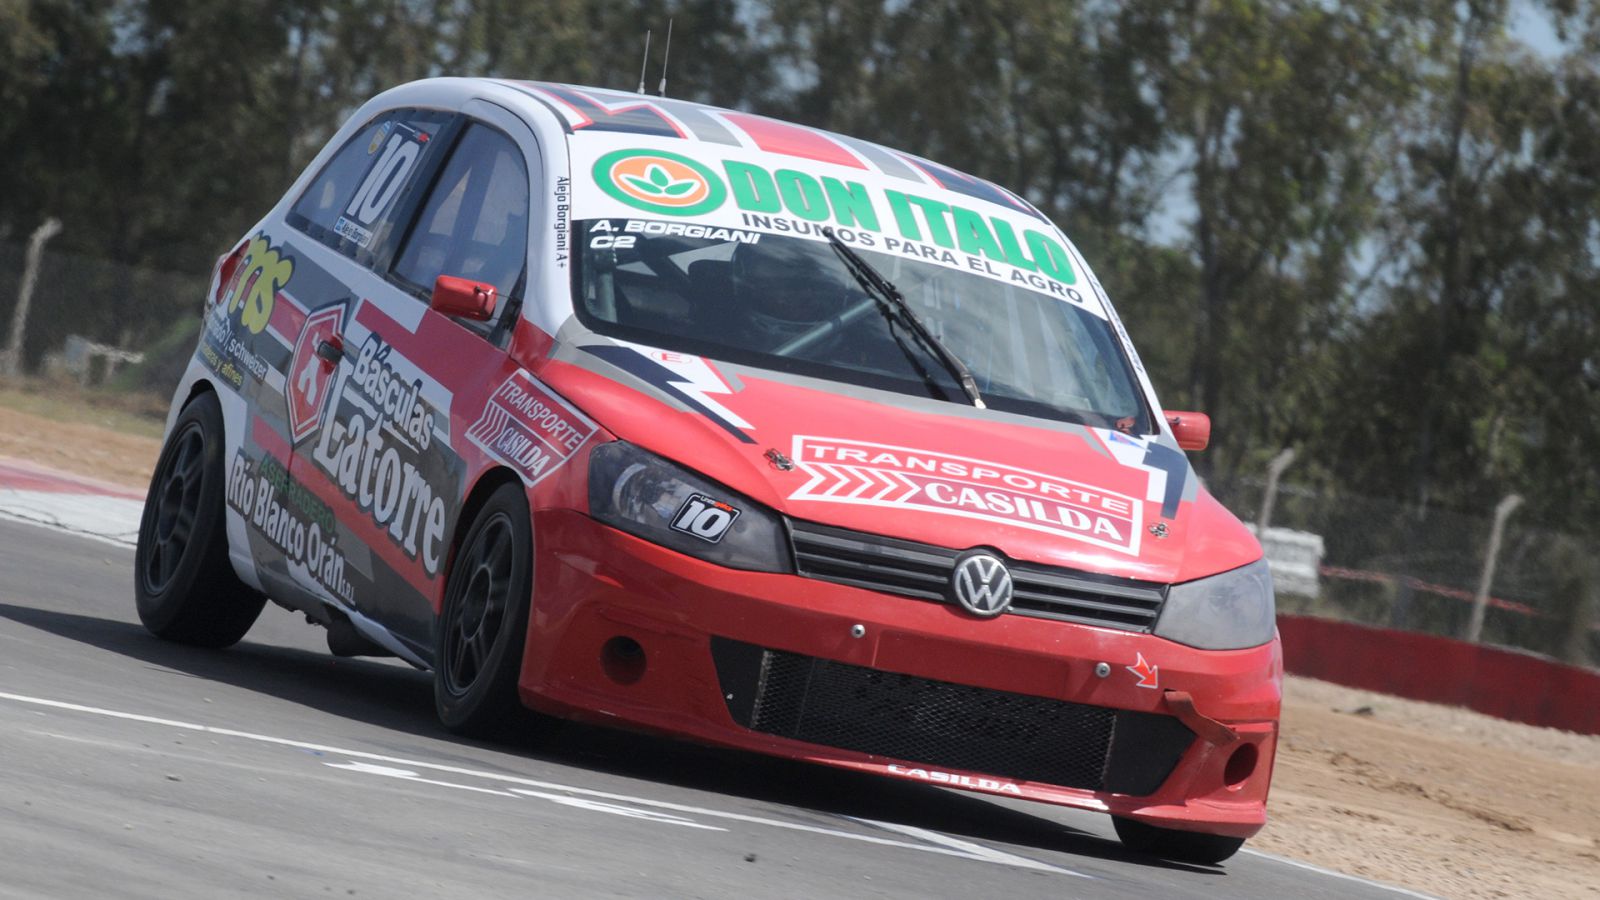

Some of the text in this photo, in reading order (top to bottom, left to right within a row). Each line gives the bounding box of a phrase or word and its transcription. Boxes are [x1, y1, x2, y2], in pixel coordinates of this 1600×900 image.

[346, 133, 420, 225] 10
[554, 175, 570, 202] Alejo
[554, 204, 569, 251] Borgiani
[589, 219, 761, 246] A. BORGIANI
[589, 235, 637, 250] C2
[721, 158, 1077, 286] DON ITALO
[742, 213, 1084, 304] INSUMOS PARA EL AGRO
[352, 338, 434, 451] Básculas
[499, 380, 584, 451] TRANSPORTE
[312, 356, 446, 575] Latorre
[496, 426, 551, 477] CASILDA
[805, 444, 1130, 515] TRANSPORTE
[229, 453, 255, 516] Río
[254, 476, 305, 561] Blanco
[307, 522, 345, 594] Orán
[260, 453, 337, 534] ASERRADERO
[675, 500, 731, 538] 10
[924, 481, 1124, 541] CASILDA
